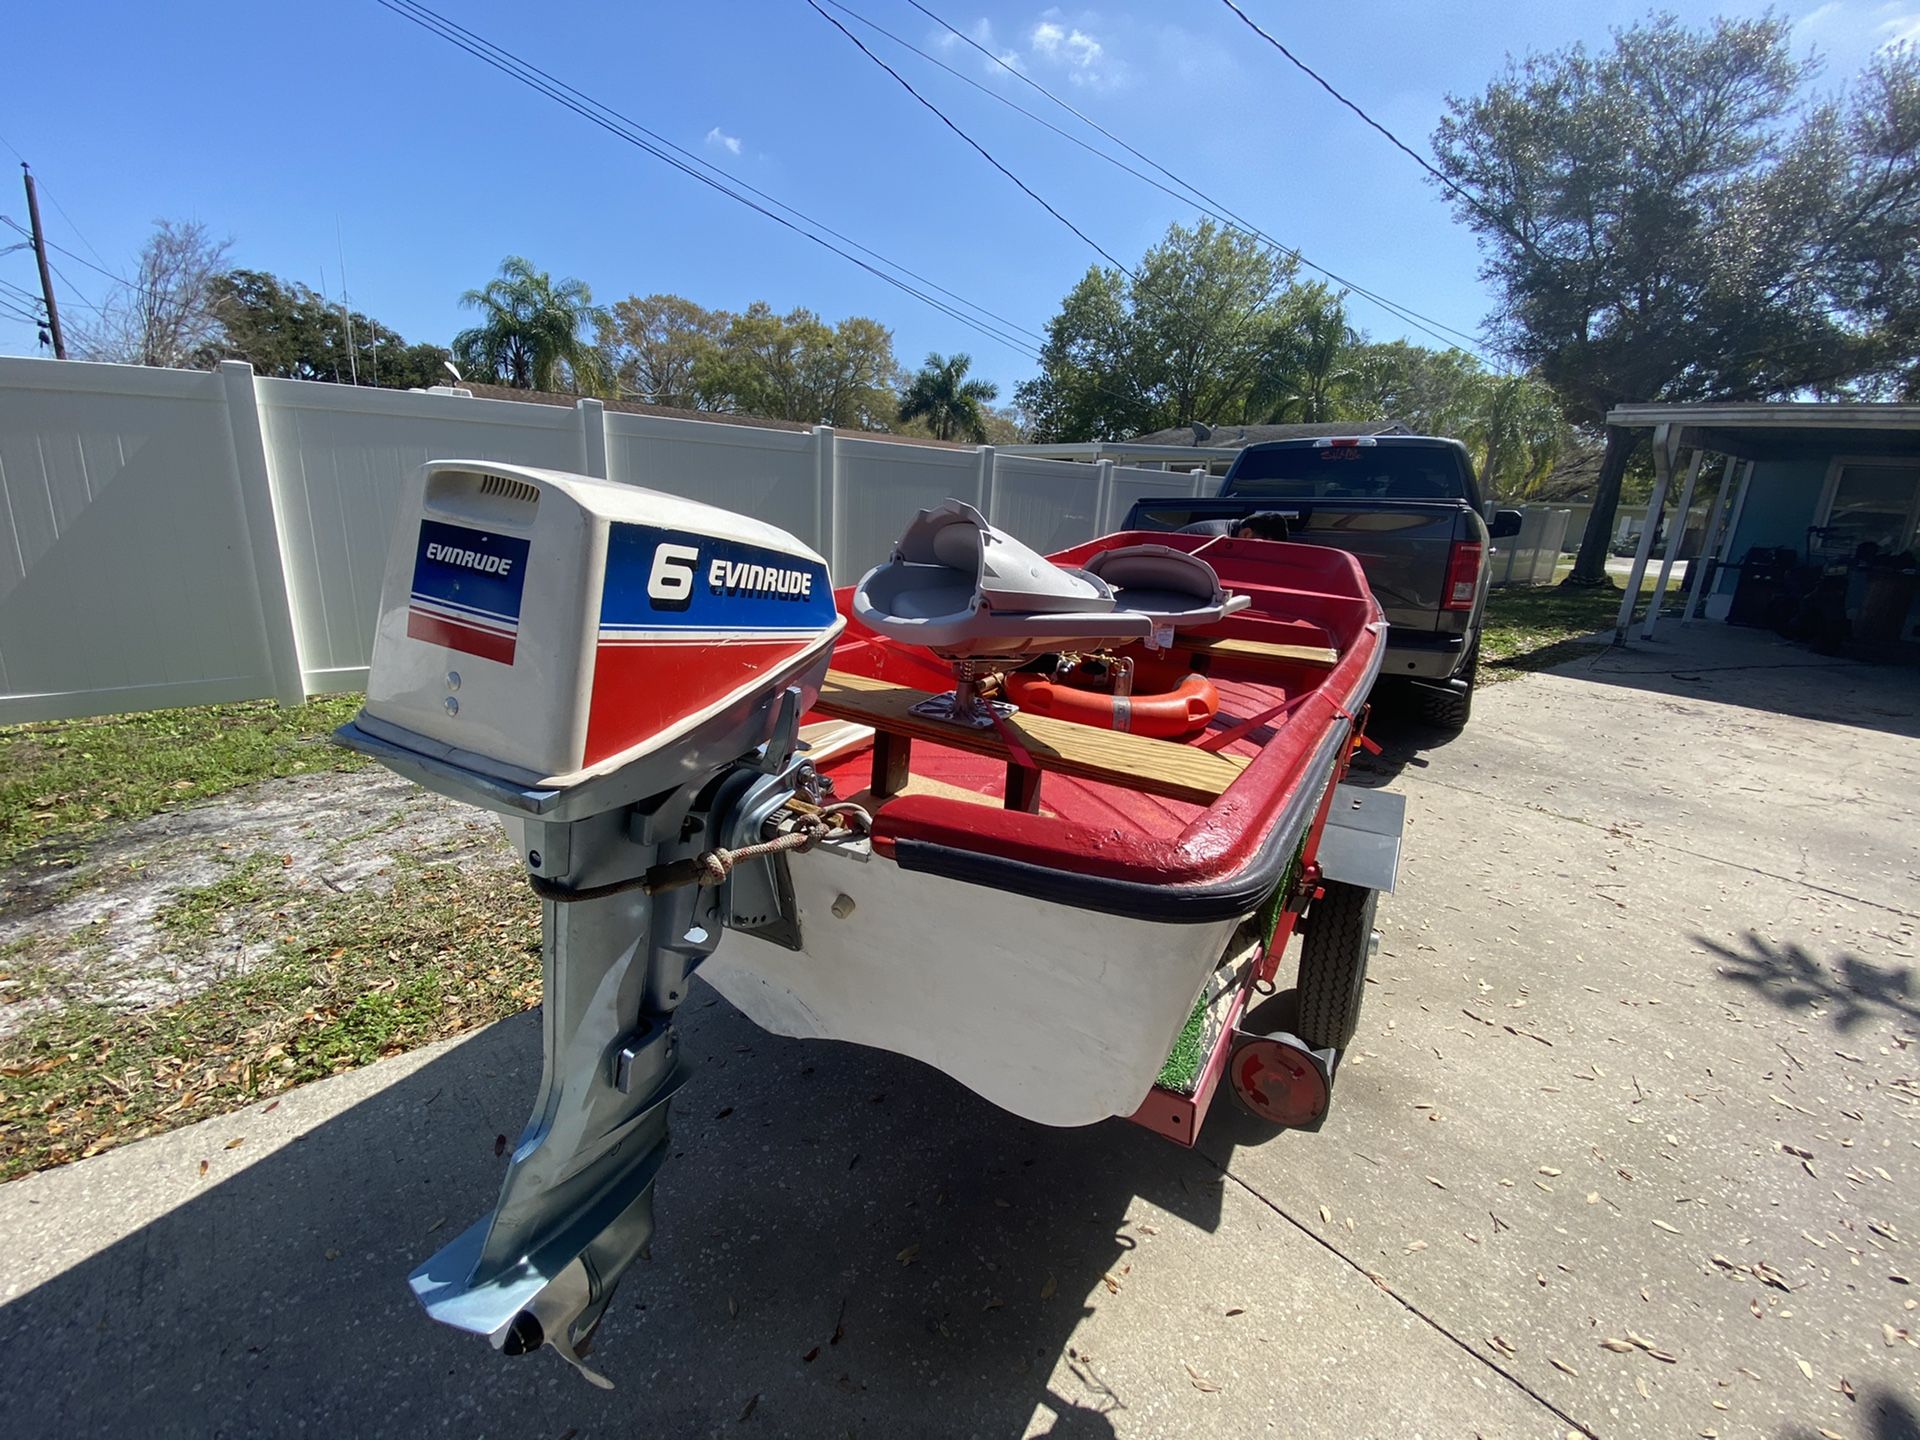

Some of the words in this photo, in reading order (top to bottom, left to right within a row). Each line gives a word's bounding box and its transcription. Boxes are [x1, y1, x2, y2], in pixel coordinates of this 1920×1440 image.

[426, 542, 513, 576] EVINRUDE
[647, 542, 699, 601] 6
[708, 559, 812, 596] EVINRUDE
